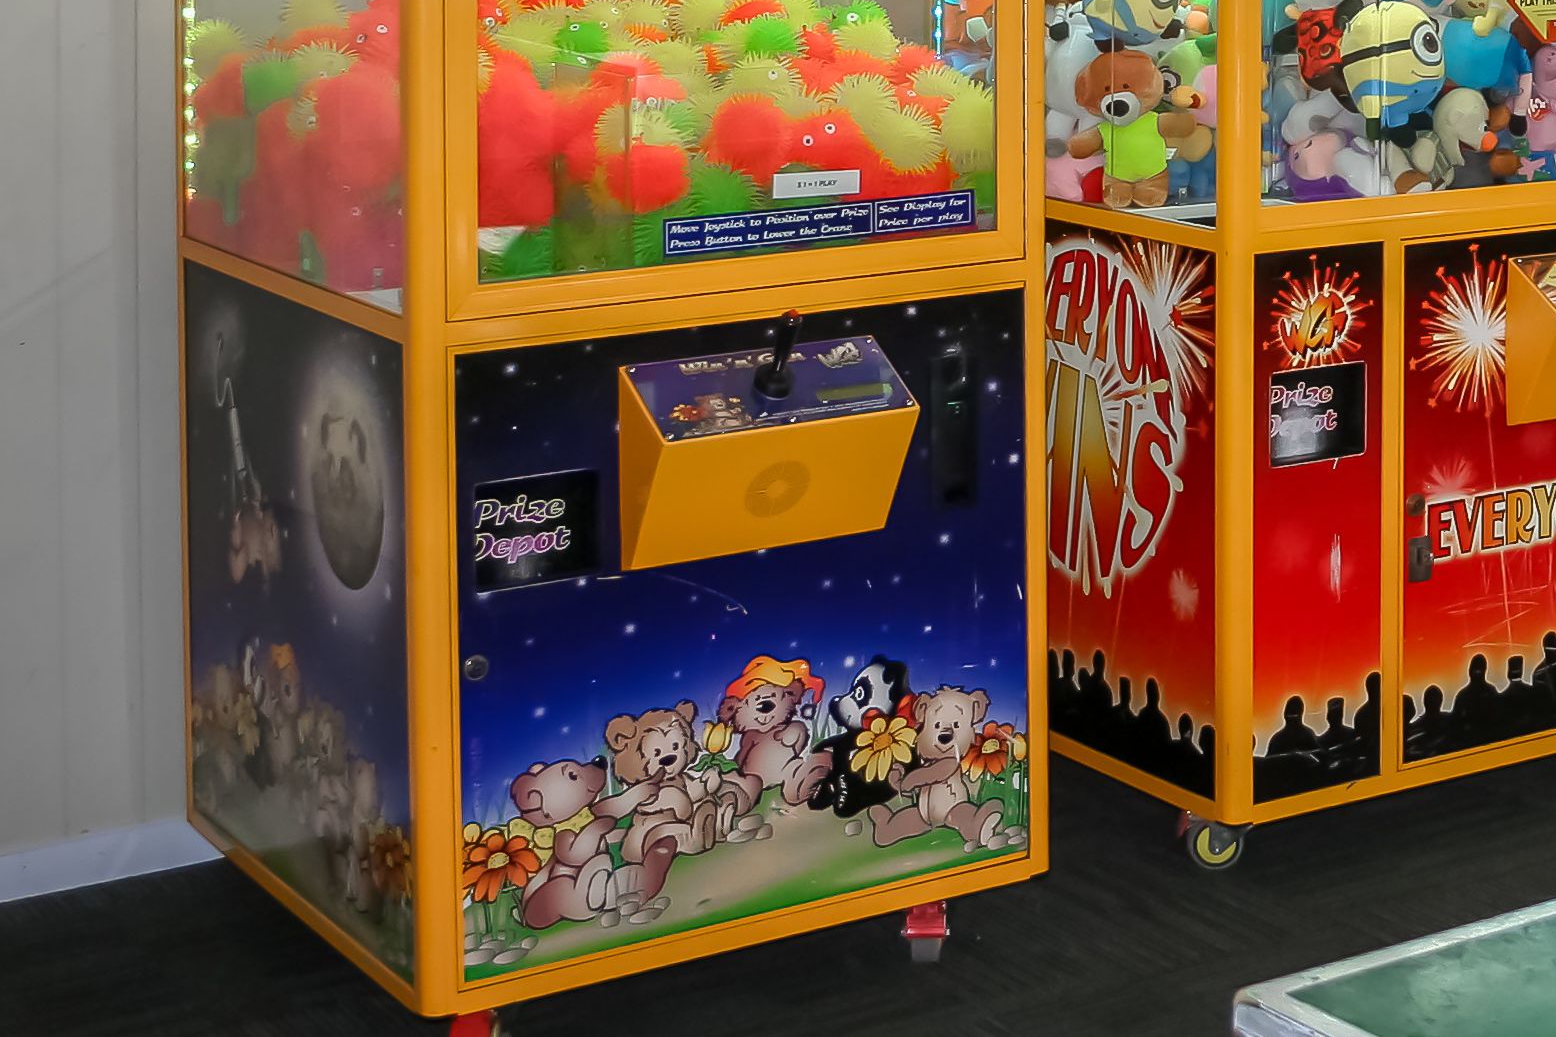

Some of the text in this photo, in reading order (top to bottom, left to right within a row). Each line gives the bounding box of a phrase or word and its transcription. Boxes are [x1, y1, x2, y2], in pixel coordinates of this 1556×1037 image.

[878, 198, 967, 214] See Display for
[669, 224, 699, 234] Move
[703, 219, 746, 233] Joystick
[750, 219, 762, 227] to
[813, 211, 837, 220] over
[841, 207, 869, 217] Prize
[912, 215, 933, 225] per
[937, 212, 964, 222] play
[669, 239, 701, 249] Press
[704, 235, 743, 247] Button
[747, 232, 760, 240] to
[763, 229, 796, 239] Lower
[799, 225, 817, 235] the
[474, 494, 565, 529] Prize
